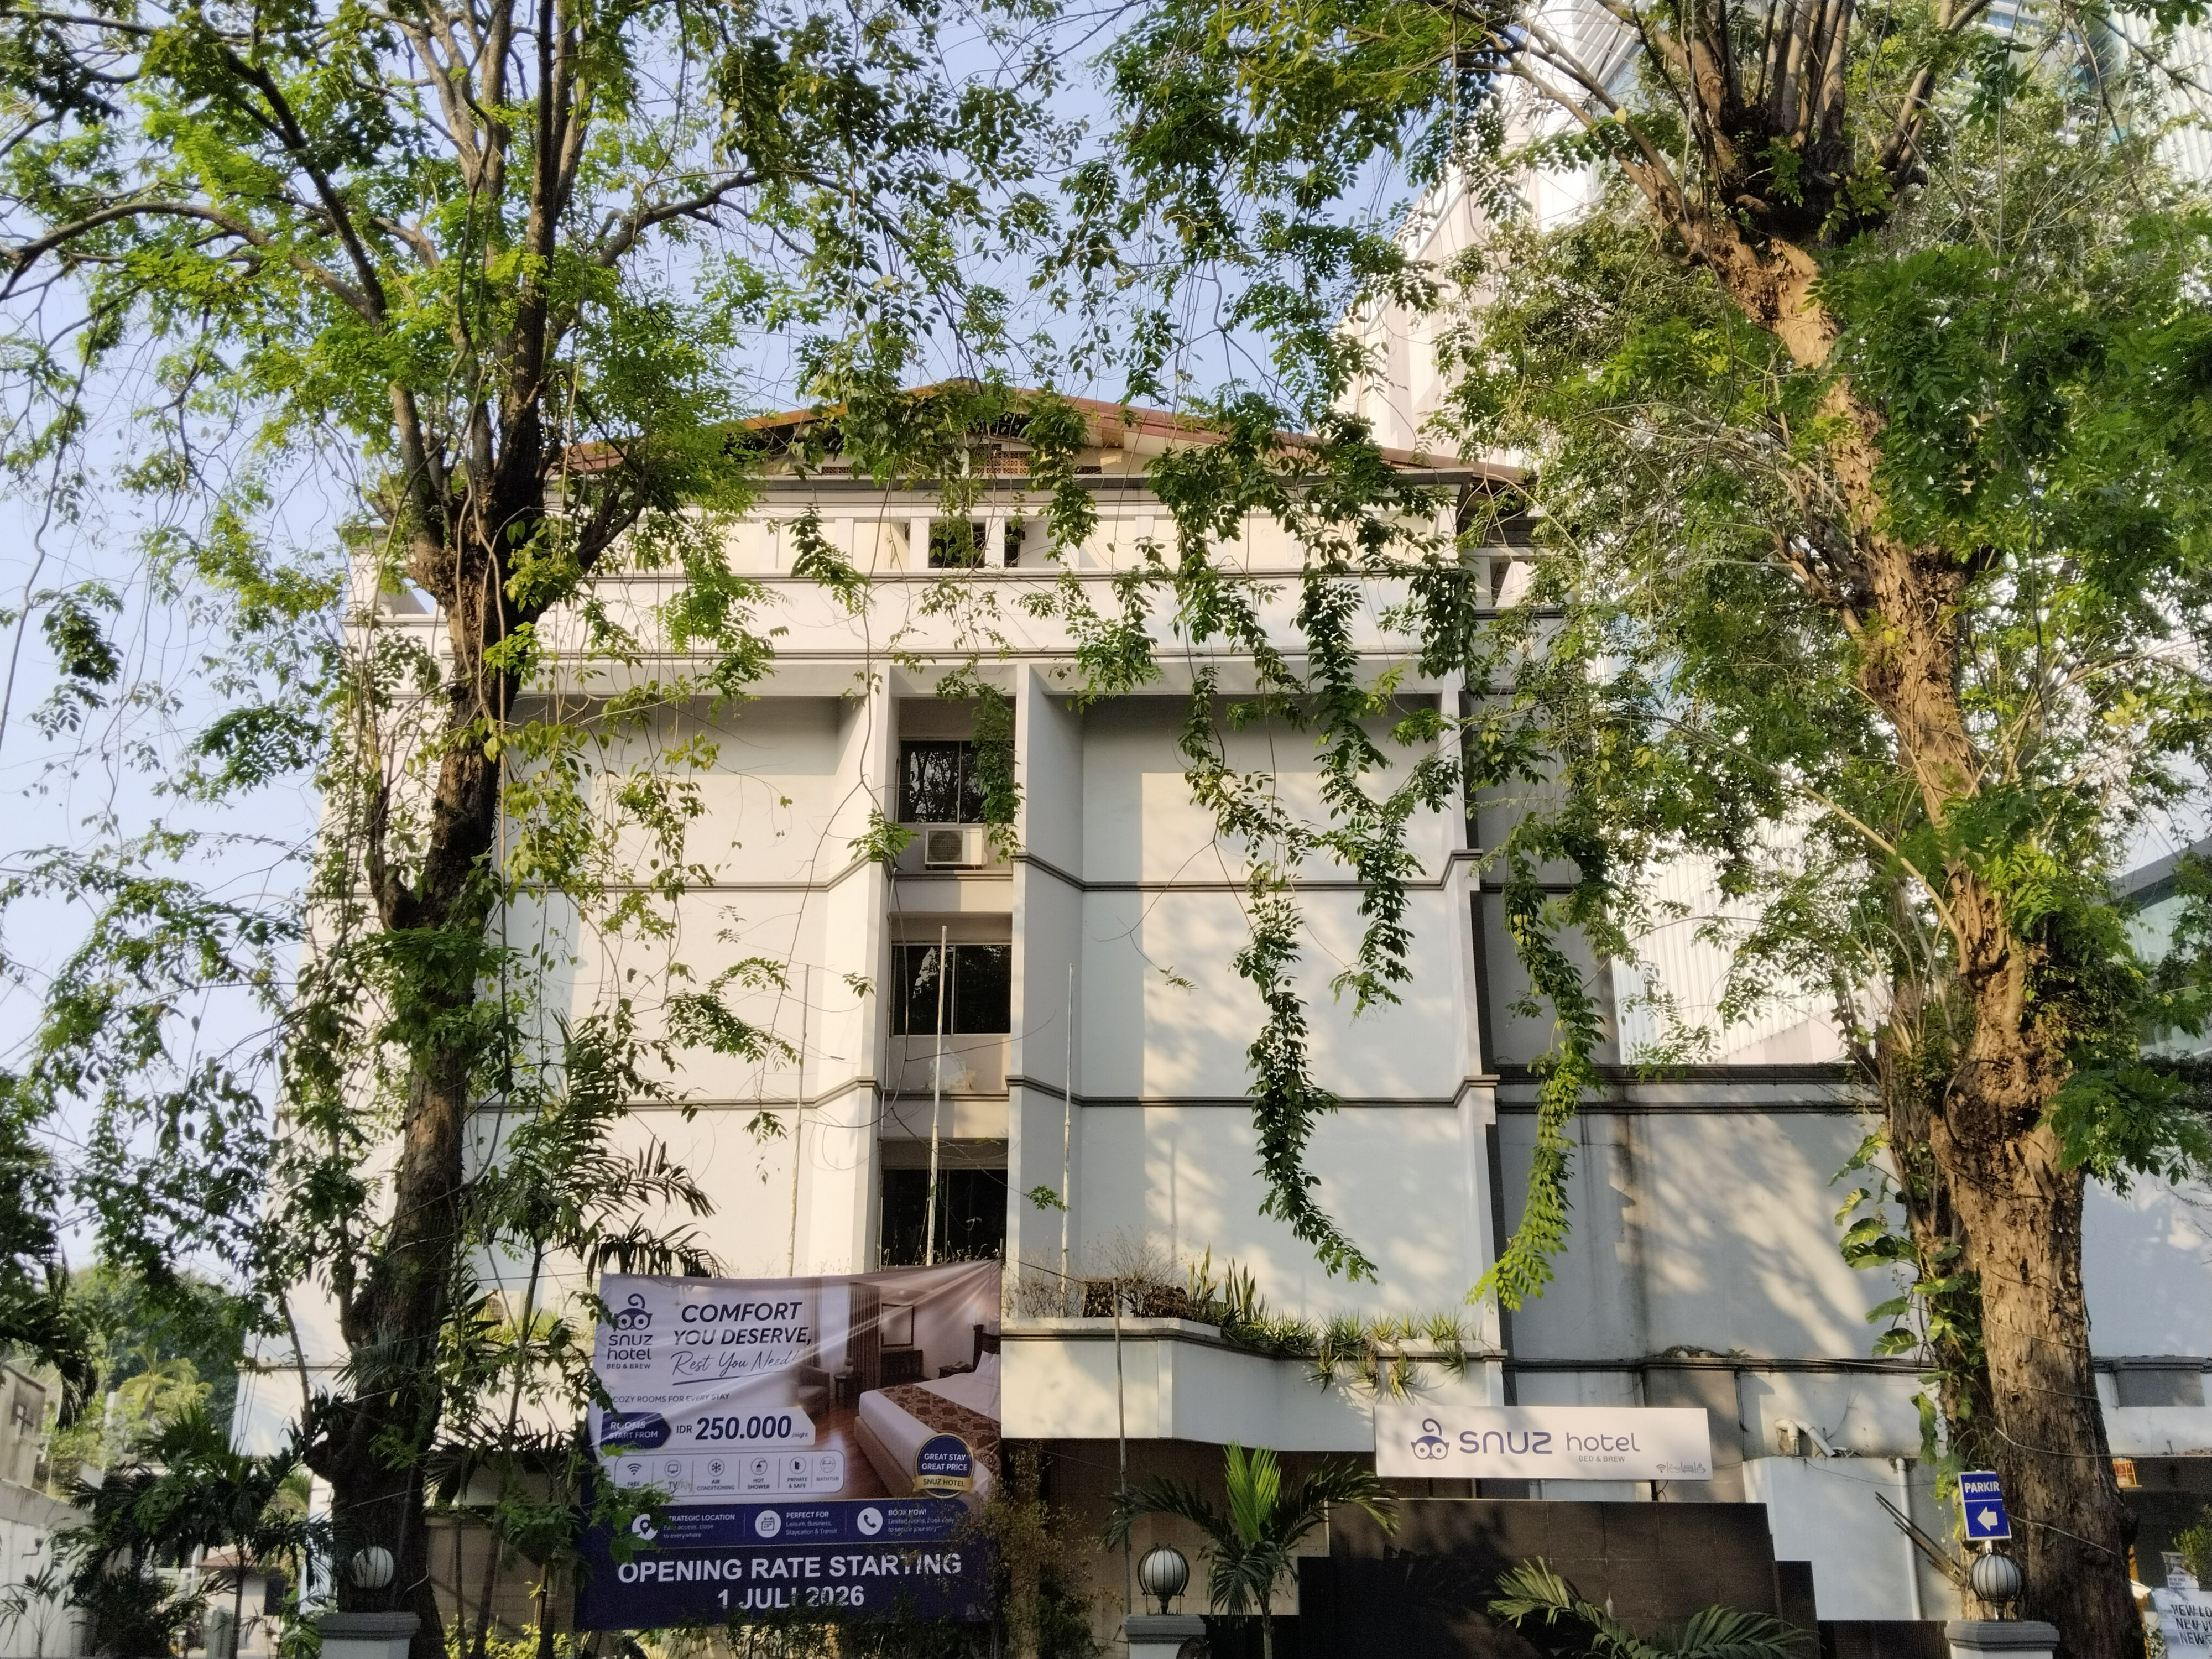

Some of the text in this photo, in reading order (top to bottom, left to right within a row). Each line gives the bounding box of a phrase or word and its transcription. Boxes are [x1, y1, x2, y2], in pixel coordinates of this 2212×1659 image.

[681, 1302, 803, 1323] COMFORT
[609, 1334, 653, 1346] snuz
[674, 1327, 812, 1345] YOU DESERVE,
[607, 1348, 652, 1360] hotel
[670, 1350, 800, 1378] Rest You Need!
[686, 1394, 711, 1402] EVERY
[610, 1421, 646, 1430] ROOMS
[676, 1425, 692, 1433] IDR
[695, 1415, 792, 1440] 250.000
[1459, 1430, 1641, 1454] snuz hotel
[1964, 1481, 2000, 1493] PARKIR
[618, 1558, 742, 1583] OPENING
[751, 1557, 821, 1579] RATE
[718, 1585, 865, 1609] 1 JULI 2026
[2170, 1604, 2196, 1616] NEW
[2175, 1618, 2199, 1630] NEW
[2179, 1632, 2205, 1645] NEW
